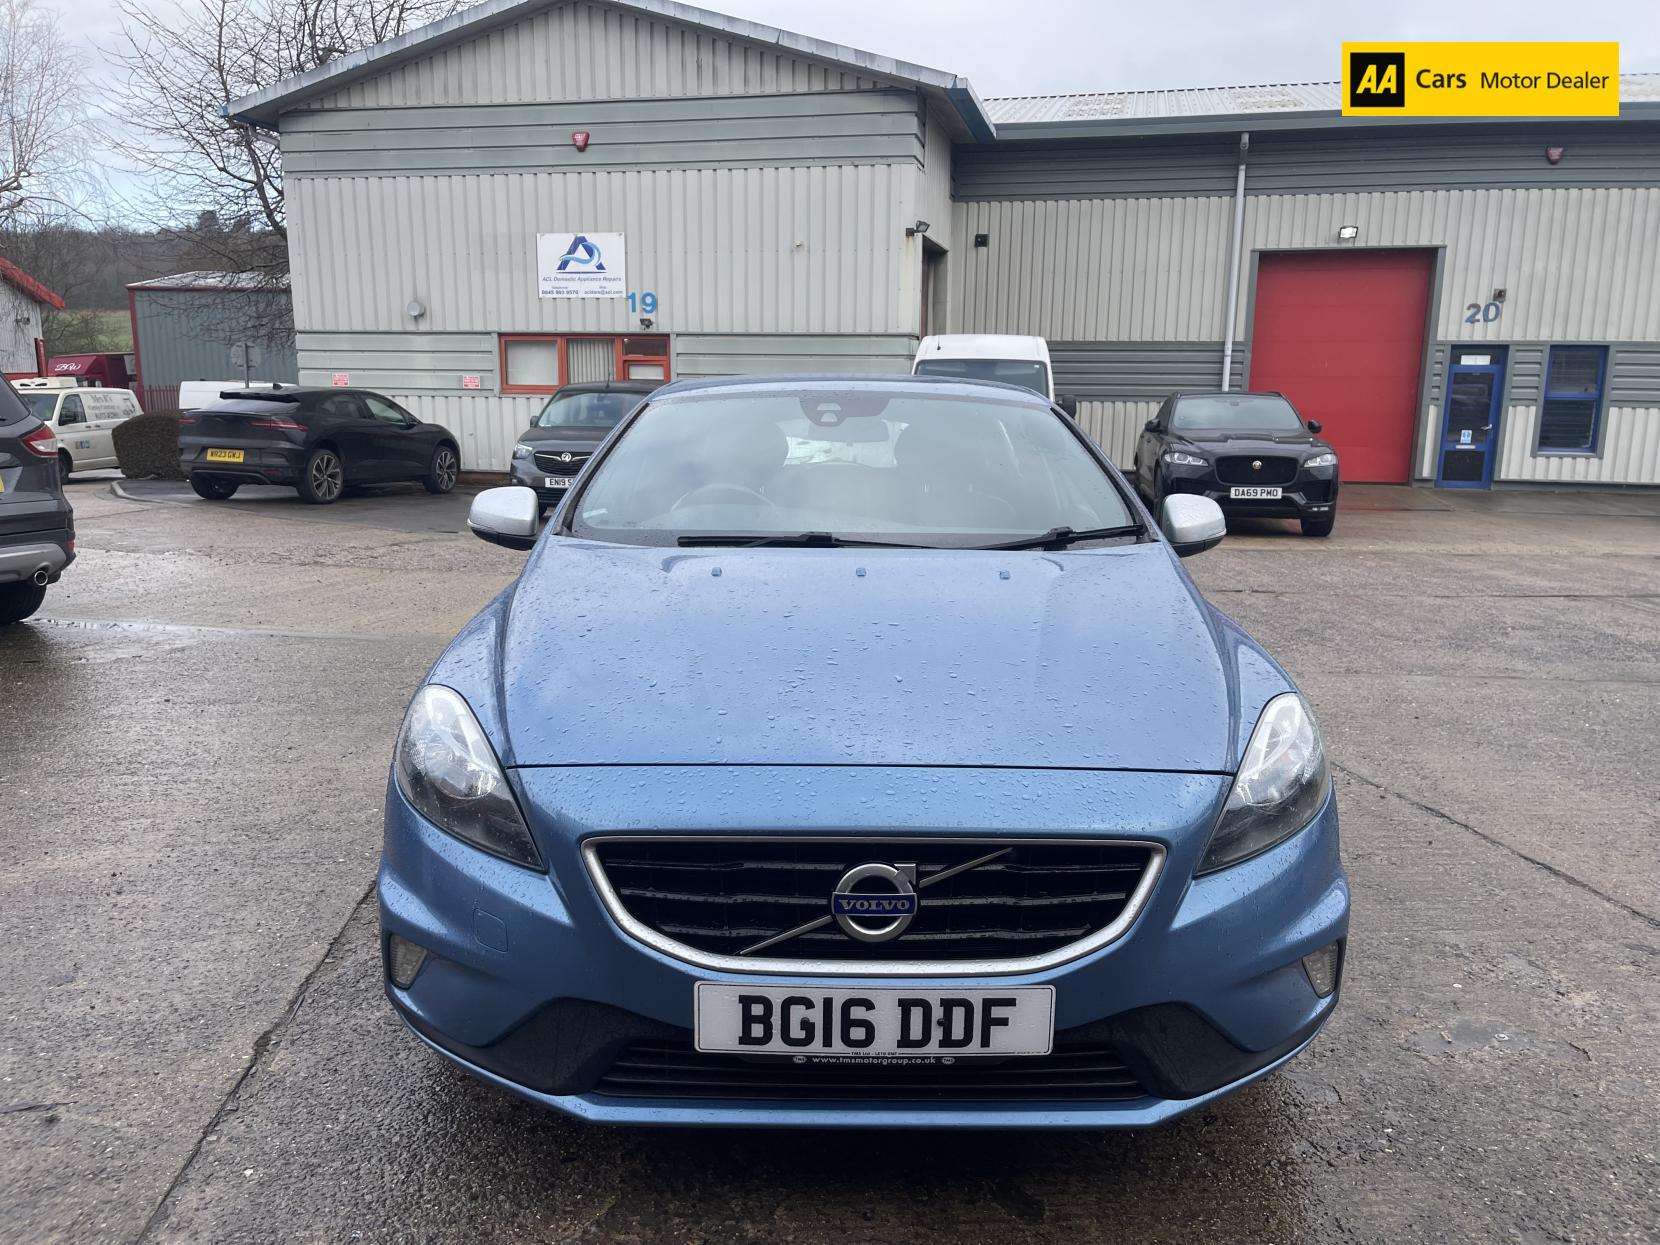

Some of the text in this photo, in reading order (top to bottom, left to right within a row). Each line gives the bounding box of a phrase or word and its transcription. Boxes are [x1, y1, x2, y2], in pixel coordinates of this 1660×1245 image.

[627, 291, 657, 314] 19
[1464, 302, 1501, 324] 20
[1234, 488, 1258, 497] DA69
[838, 899, 910, 911] VOLVO
[737, 993, 1017, 1049] BG16 DDF
[812, 1056, 936, 1065] www.tmsmotorgroup.co.uk
